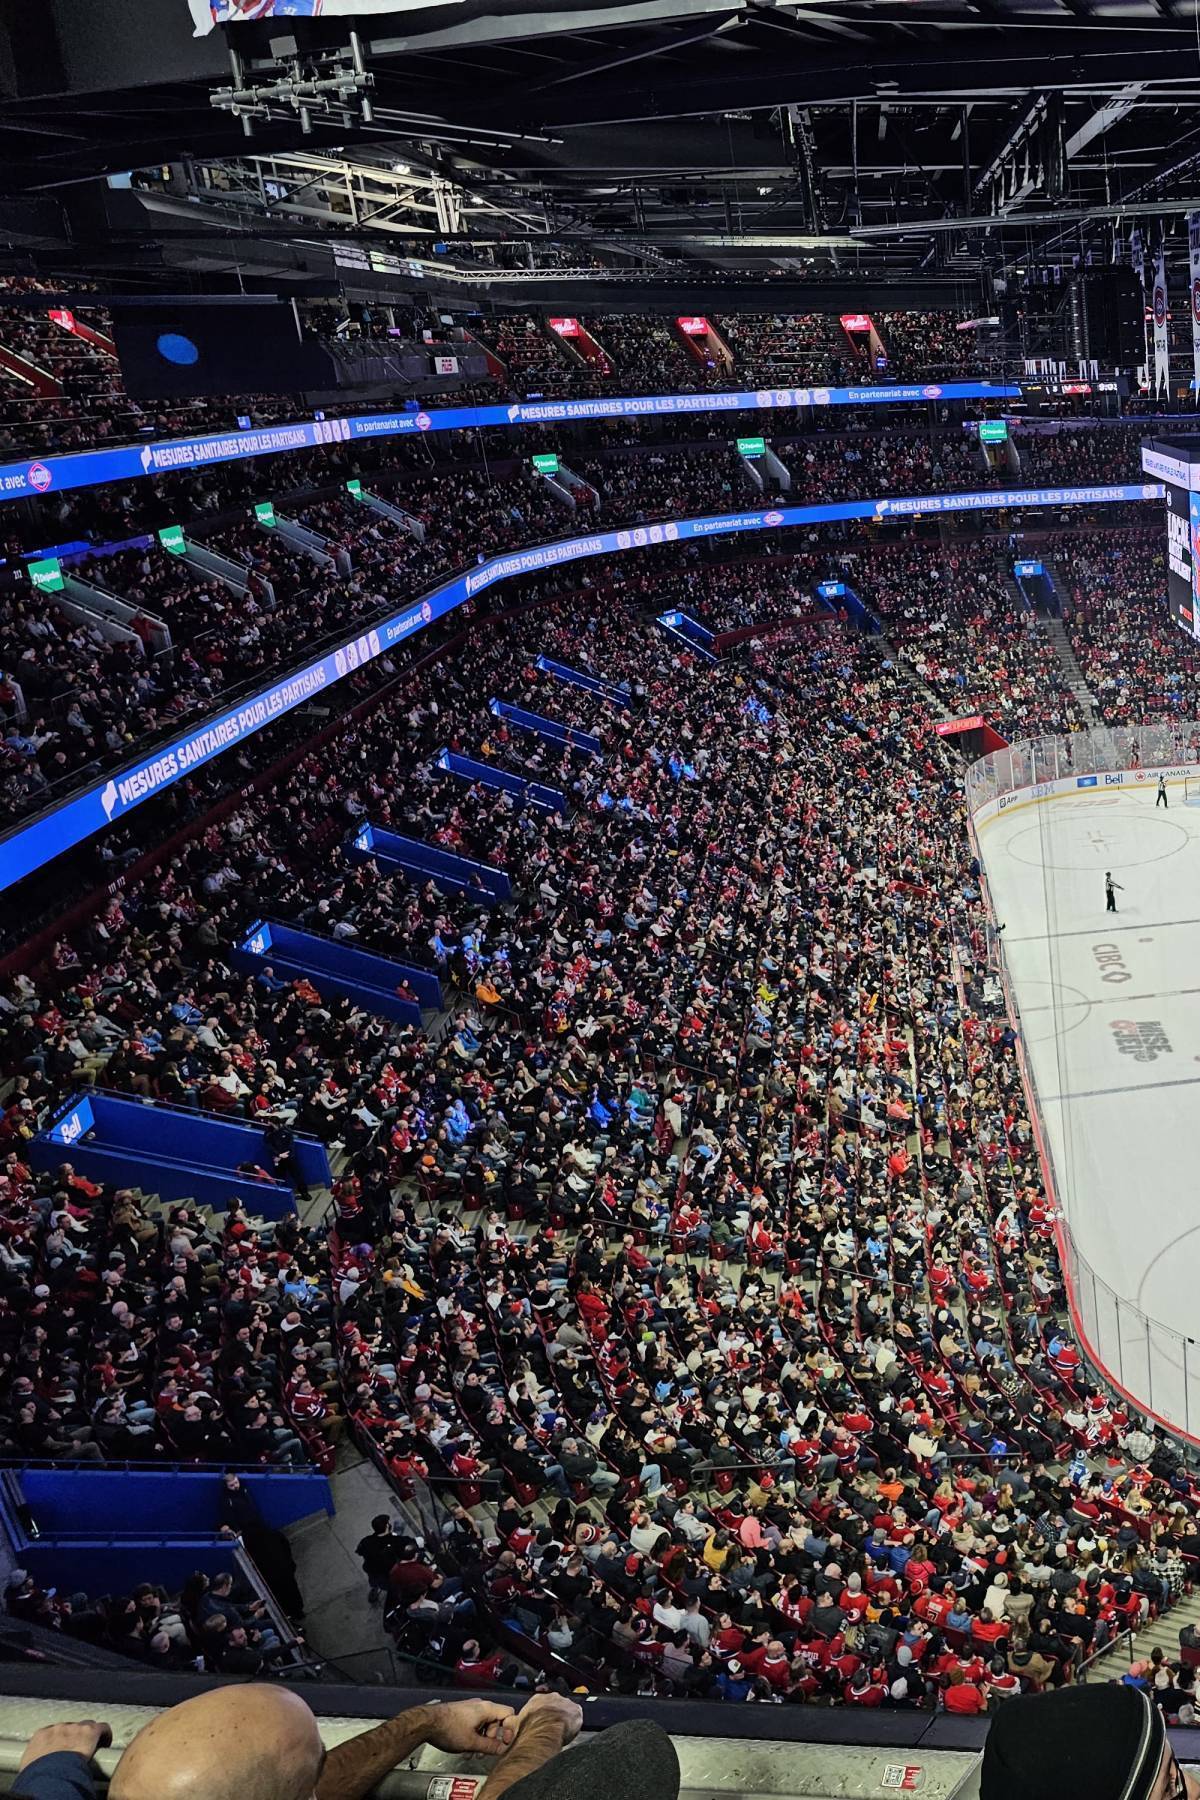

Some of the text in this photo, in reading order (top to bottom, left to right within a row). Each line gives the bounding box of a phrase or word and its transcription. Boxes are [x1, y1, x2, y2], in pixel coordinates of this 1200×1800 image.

[848, 388, 920, 401] En partenariat avec
[521, 396, 739, 419] MESURES SANITAIRES POUR LES PARTISANS
[364, 418, 399, 433] partenariat
[153, 430, 306, 468] MESURES SANITAIRES POUR LES PARTISANS
[5, 476, 26, 488] avec
[890, 488, 1124, 513] MESURES SANITAIRES POUR LES PARTISANS
[693, 517, 761, 533] En partenariat avec
[521, 552, 544, 569] POUR
[544, 549, 558, 563] LES
[557, 540, 602, 560] PARTISANS
[118, 666, 326, 806] MESURES SANITAIRES POUR LES PARTISANS
[1105, 774, 1124, 785] Bell
[1162, 769, 1191, 778] CANADA
[1092, 942, 1127, 973] CIBC
[61, 1113, 81, 1144] Bell
